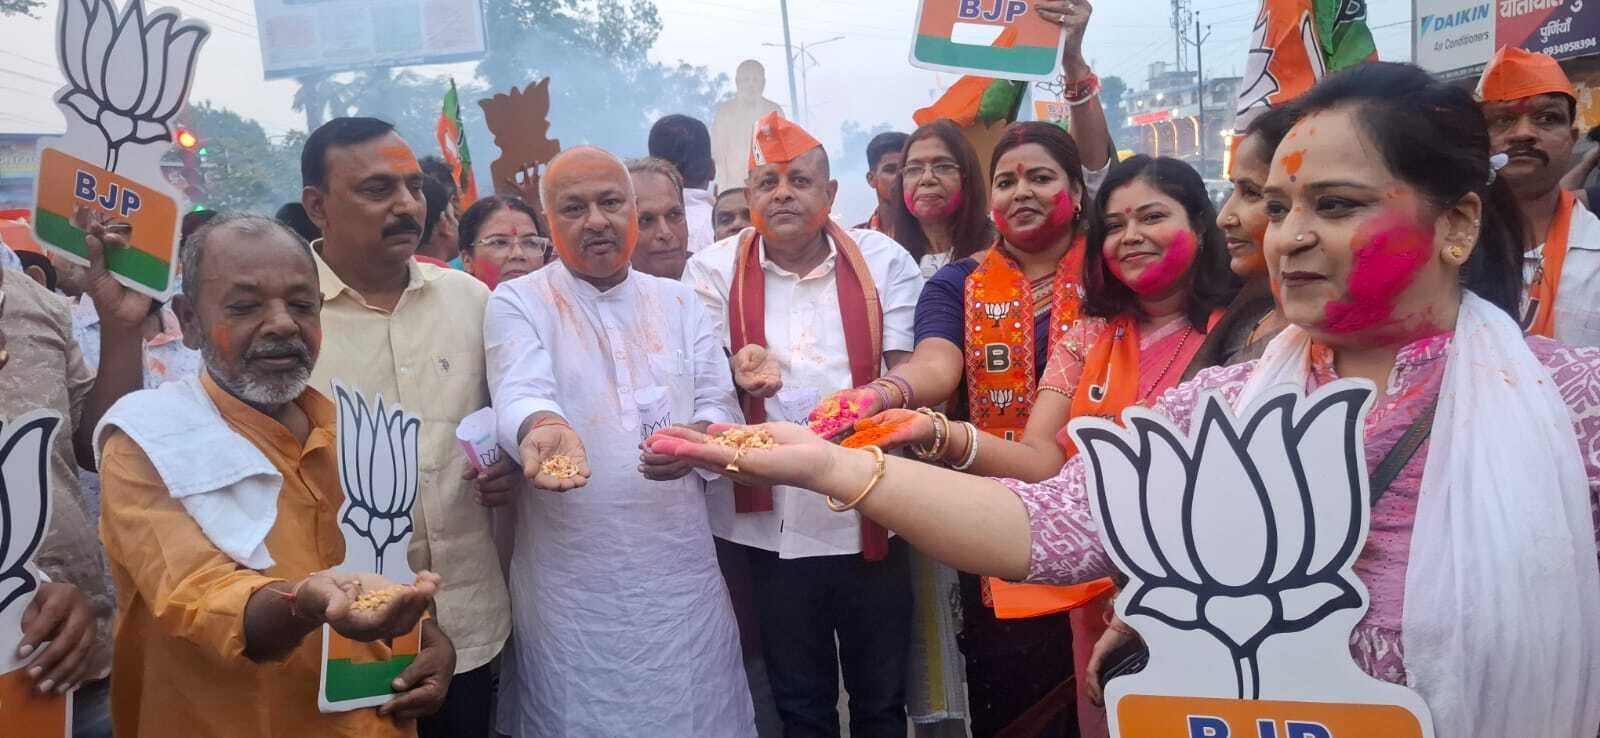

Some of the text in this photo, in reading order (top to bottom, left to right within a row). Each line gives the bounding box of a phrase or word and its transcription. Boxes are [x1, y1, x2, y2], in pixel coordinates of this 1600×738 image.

[959, 0, 1028, 23] BJP
[1433, 3, 1490, 32] DAIKIN
[1445, 31, 1490, 50] Conditioners
[75, 169, 141, 217] BJP
[985, 342, 1012, 373] B
